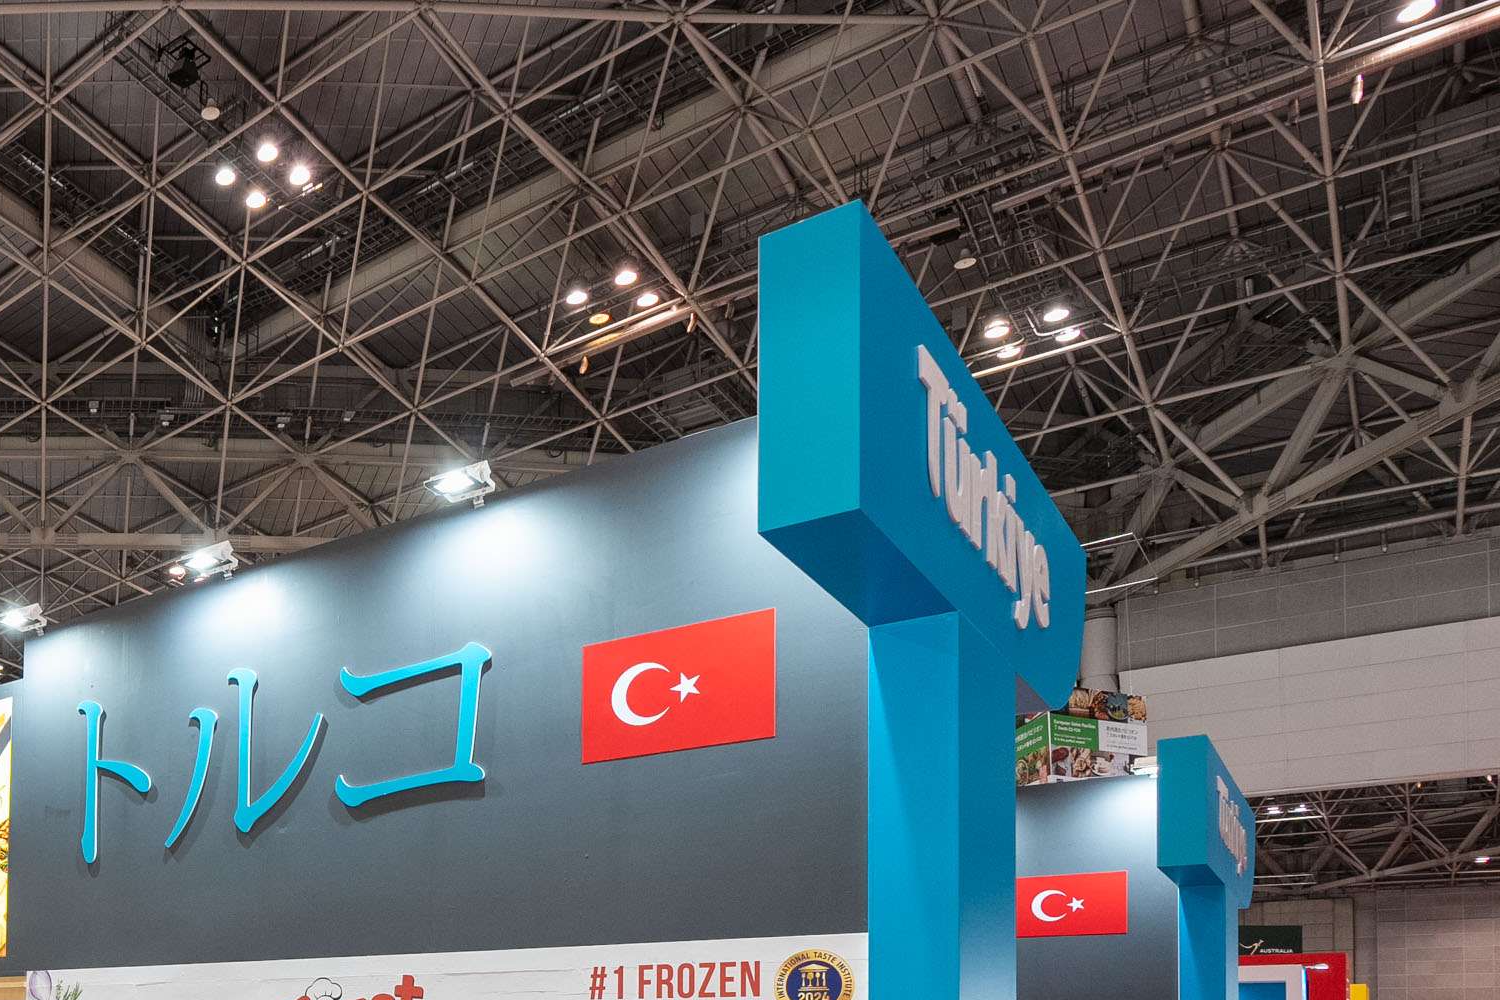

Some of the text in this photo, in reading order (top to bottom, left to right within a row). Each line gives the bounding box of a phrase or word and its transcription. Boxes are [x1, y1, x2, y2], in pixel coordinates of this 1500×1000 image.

[917, 344, 1051, 630] Türkiye
[77, 640, 493, 864] トルコ
[589, 961, 761, 1000] #1 FROZEN
[775, 951, 854, 999] INTERNATIONAL TASTE INSTITUTE
